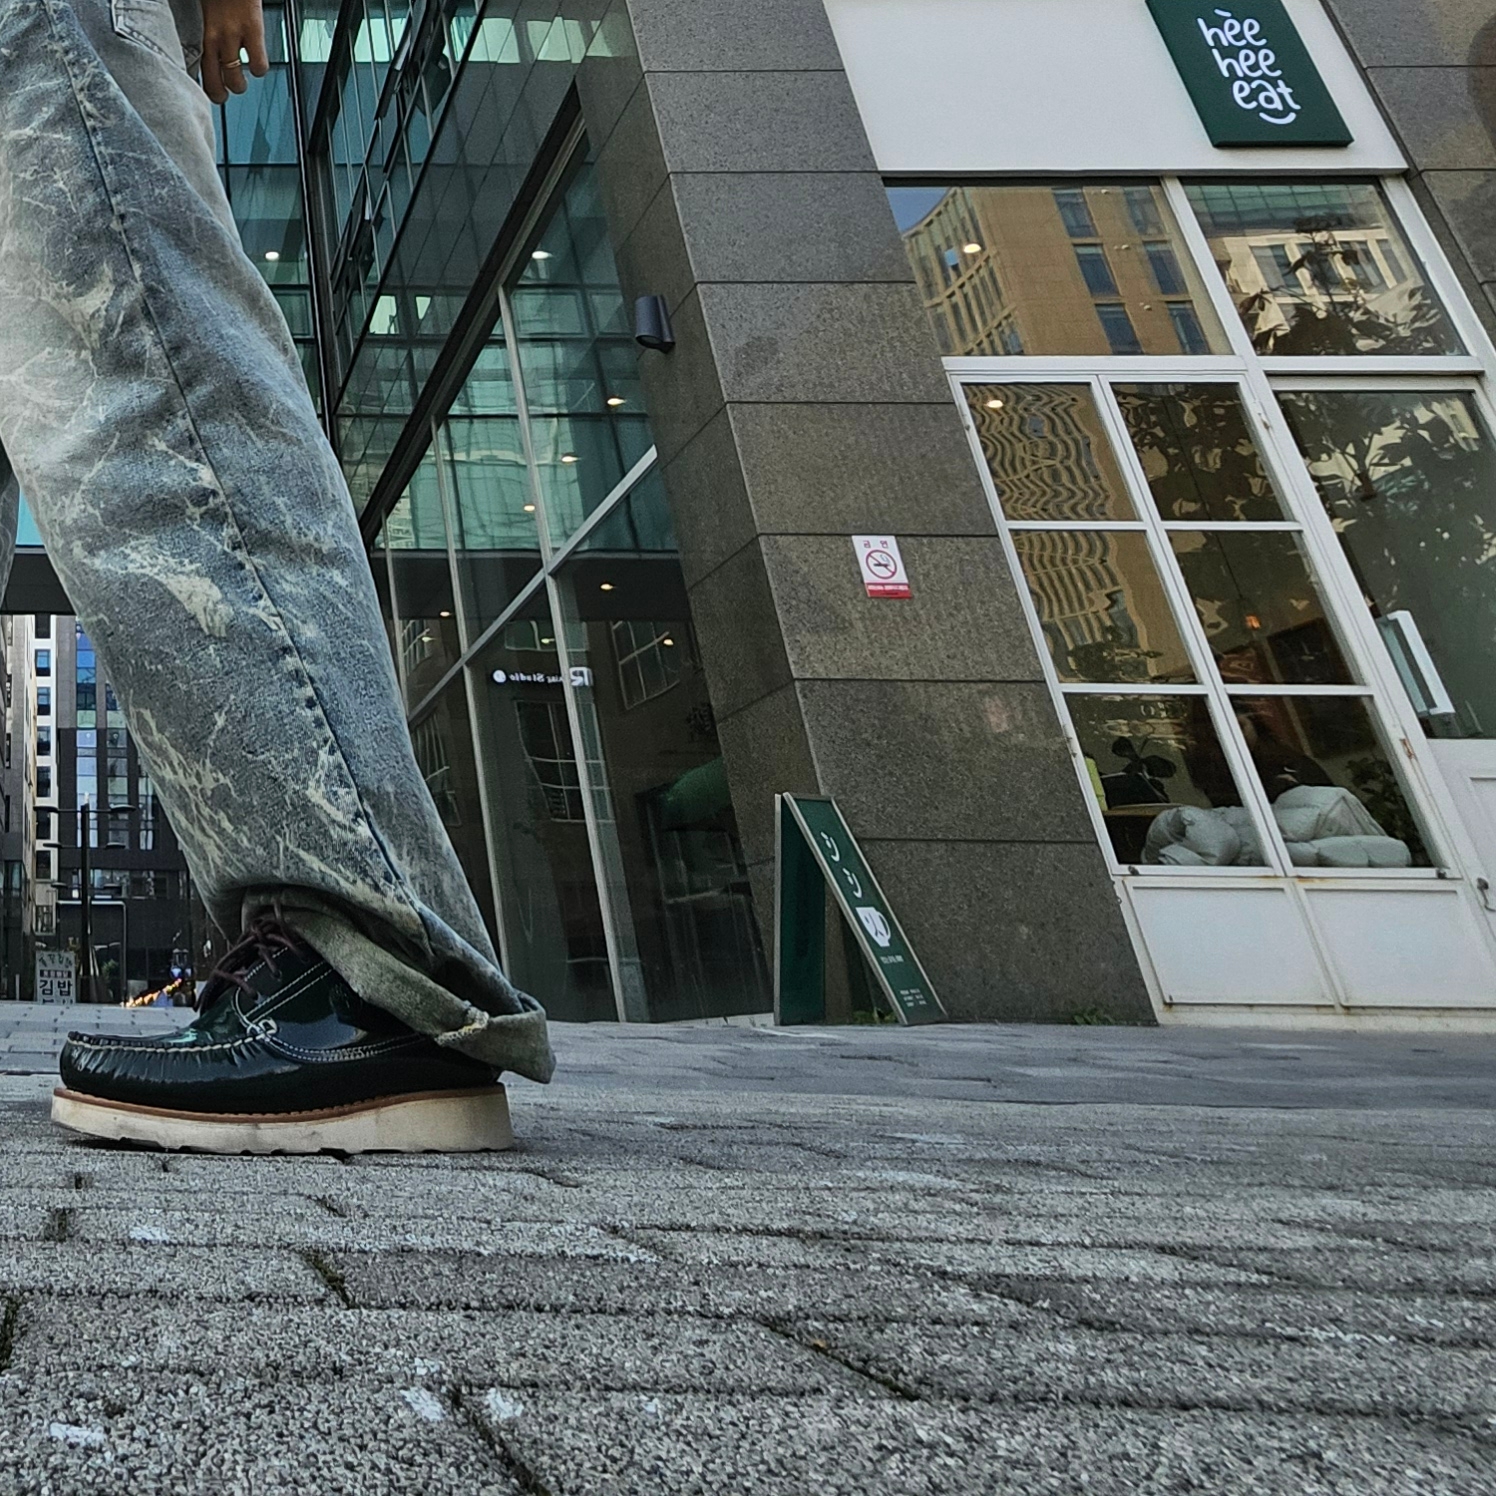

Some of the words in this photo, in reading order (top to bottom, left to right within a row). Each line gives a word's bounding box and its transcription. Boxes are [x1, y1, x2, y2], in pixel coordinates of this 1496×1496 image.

[1212, 49, 1282, 78] hee
[1232, 80, 1301, 110] eat
[40, 980, 72, 996] 김밥
